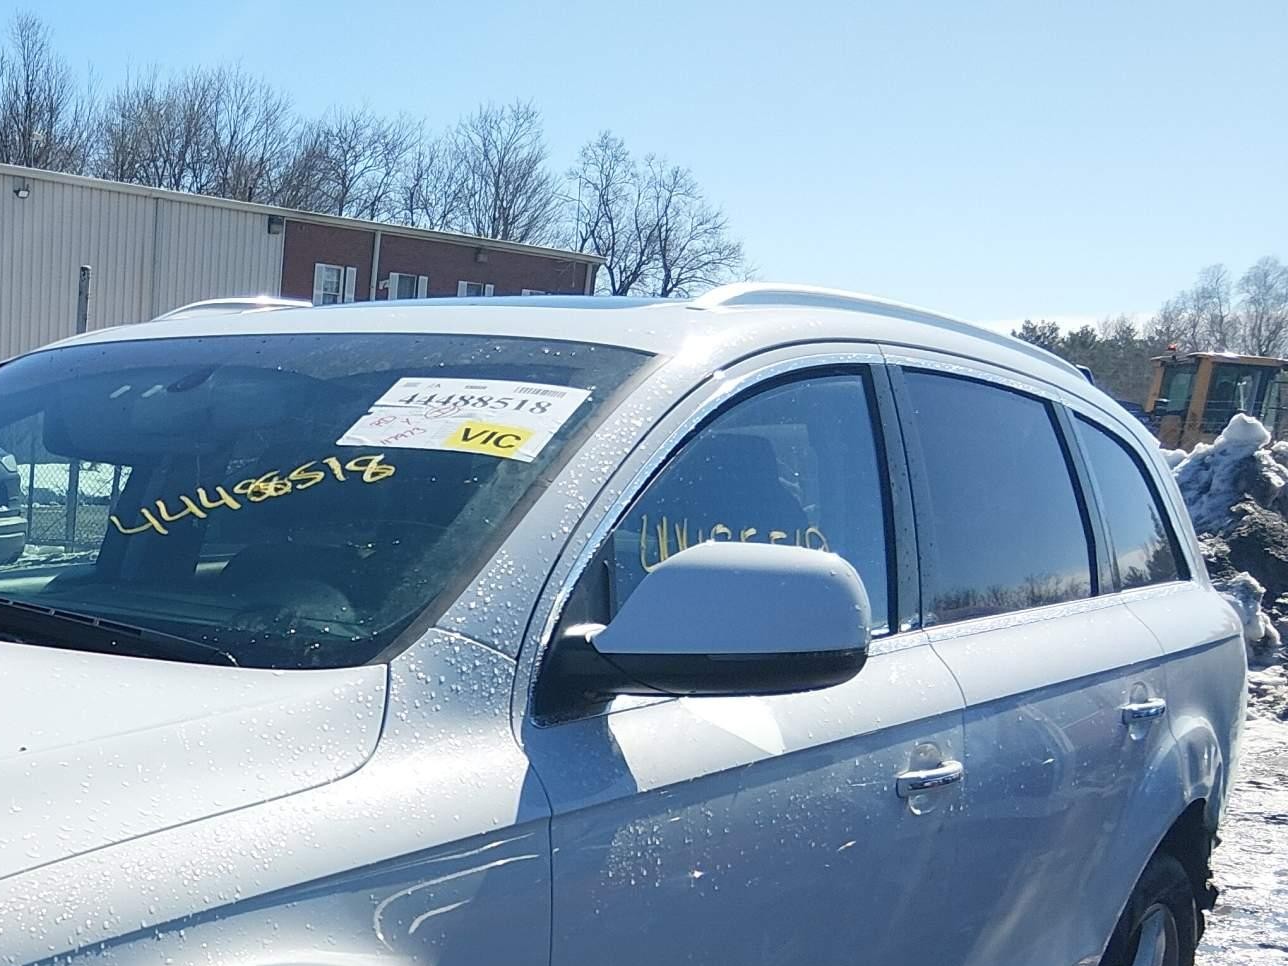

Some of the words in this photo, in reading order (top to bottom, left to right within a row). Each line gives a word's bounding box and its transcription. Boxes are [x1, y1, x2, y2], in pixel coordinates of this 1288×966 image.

[397, 392, 553, 415] 44488518
[461, 427, 522, 449] VIC
[110, 453, 396, 535] 44488518
